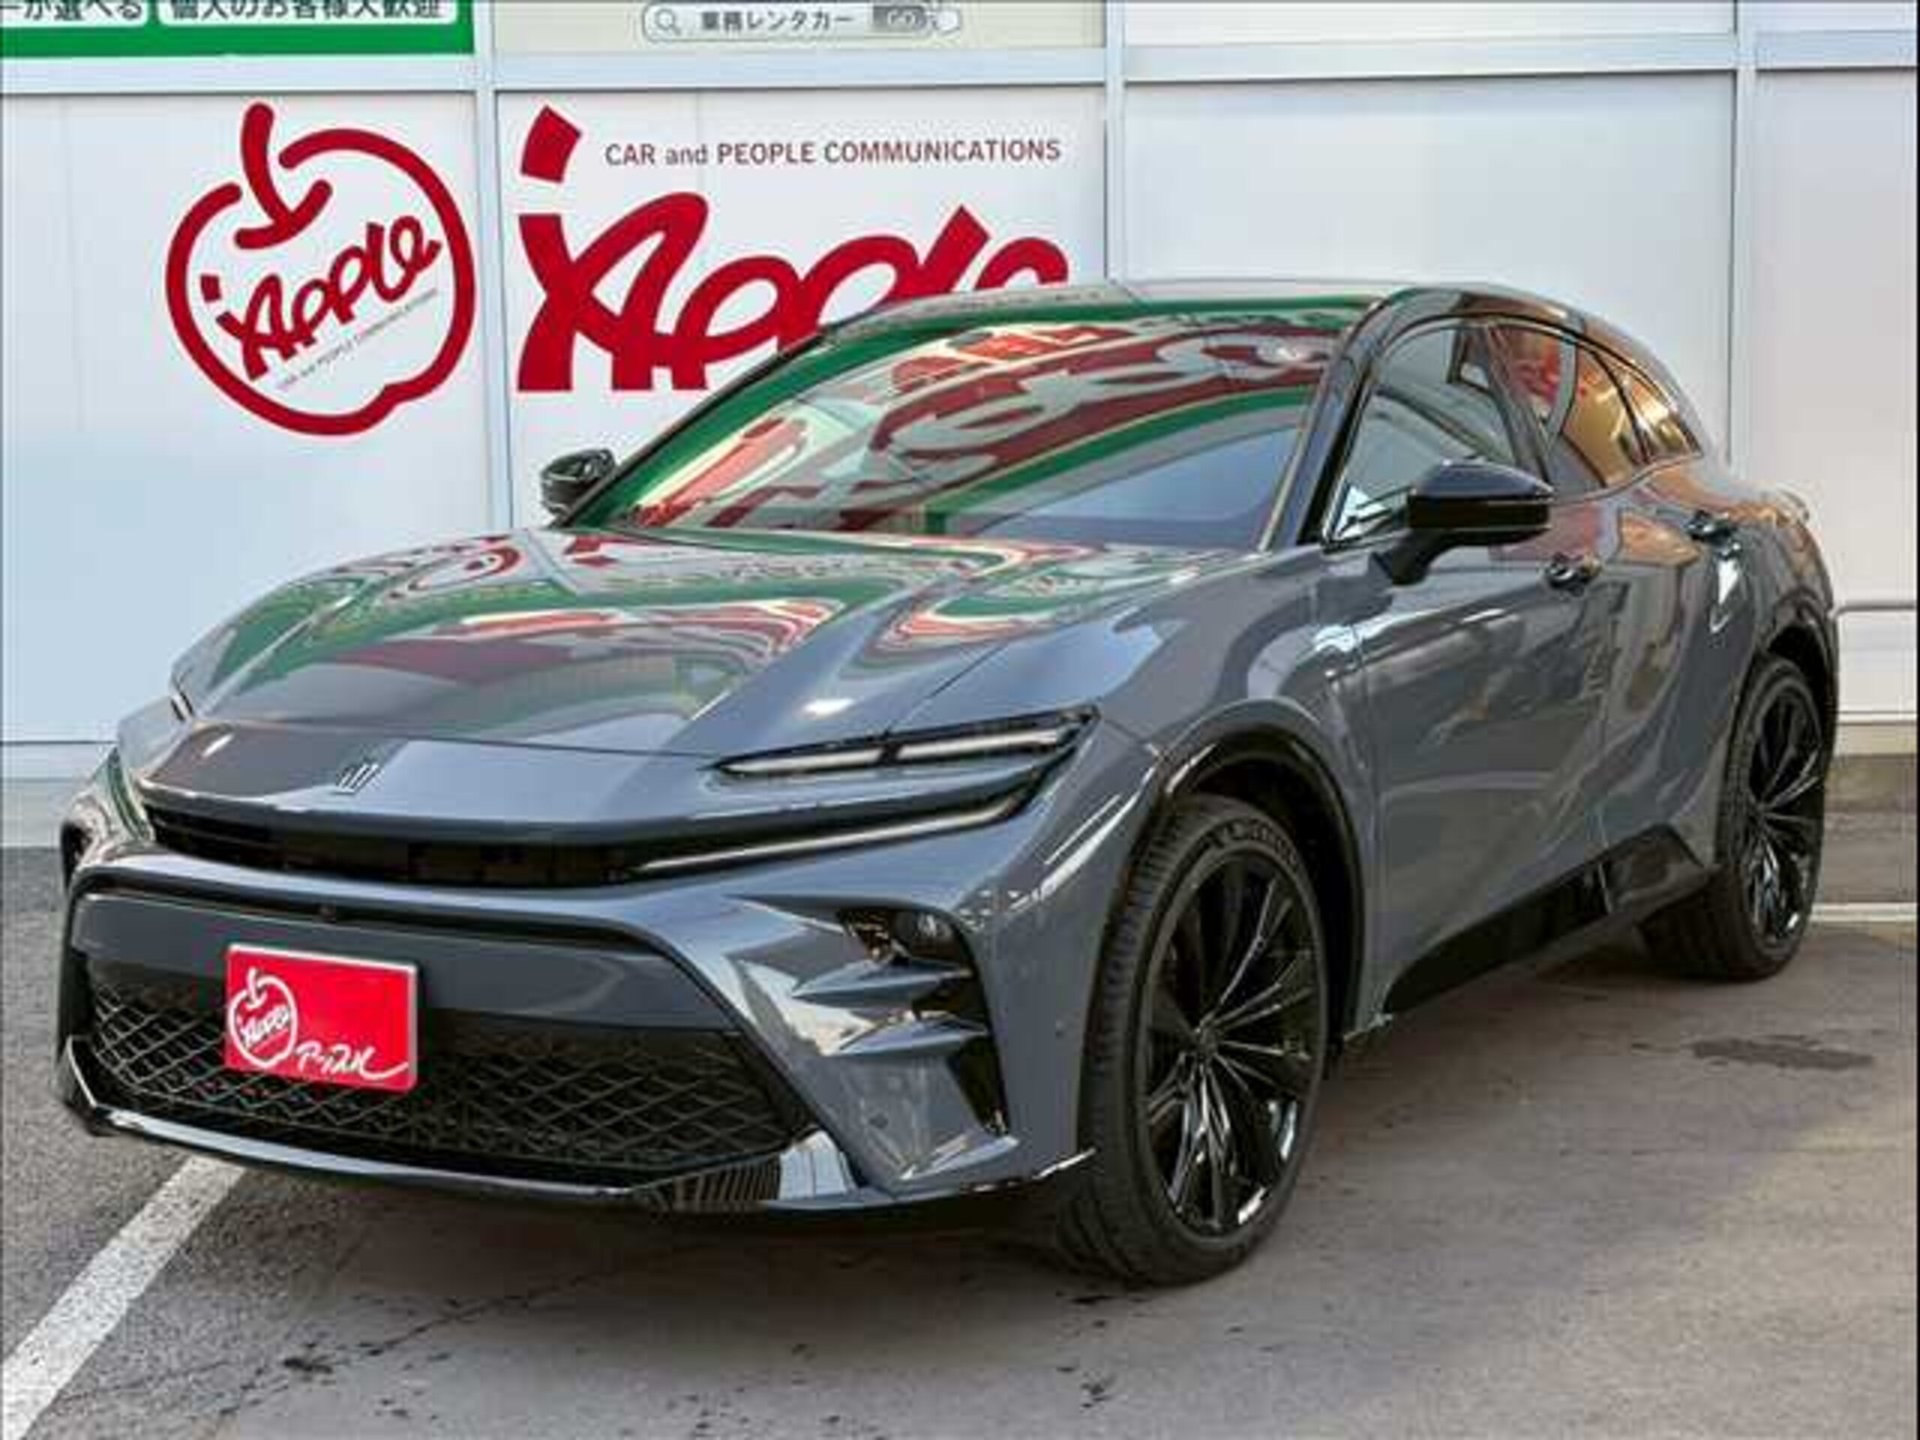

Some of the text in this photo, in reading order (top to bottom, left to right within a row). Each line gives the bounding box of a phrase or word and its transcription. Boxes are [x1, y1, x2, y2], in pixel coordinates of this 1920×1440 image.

[604, 139, 1061, 166] CAR and PEOPLE COMMUNICATIONS
